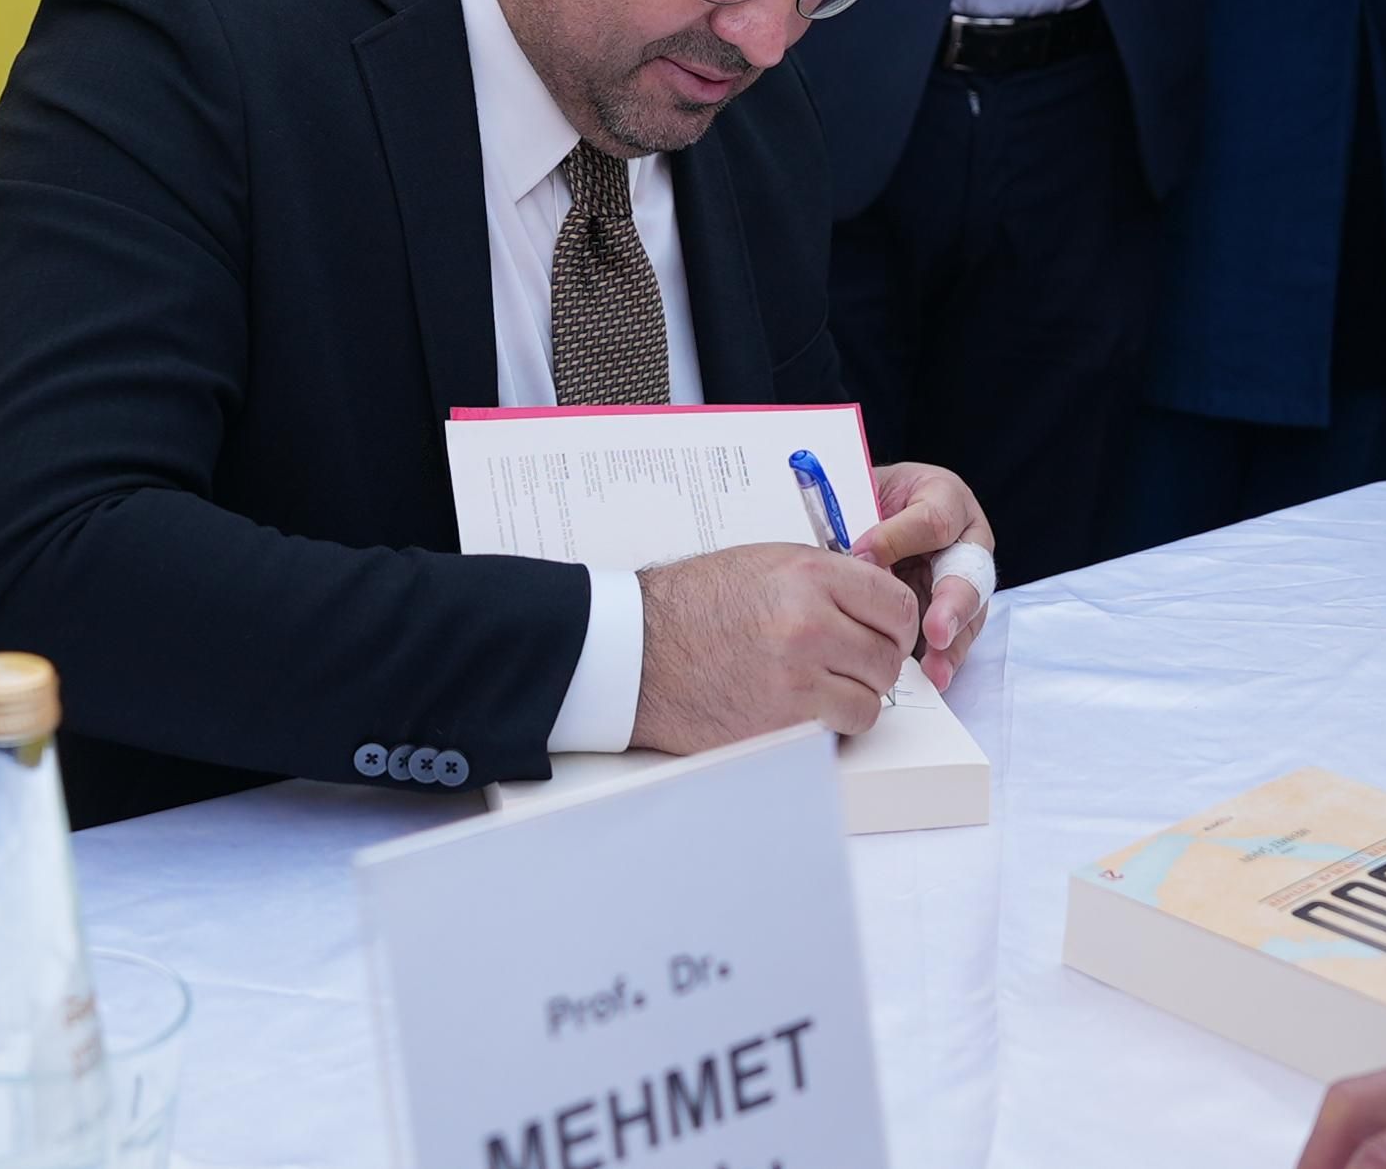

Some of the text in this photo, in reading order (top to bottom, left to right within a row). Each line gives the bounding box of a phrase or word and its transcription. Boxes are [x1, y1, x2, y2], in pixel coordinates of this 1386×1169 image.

[548, 954, 730, 1039] Prof. Dr.
[484, 1015, 816, 1169] MEHMET
